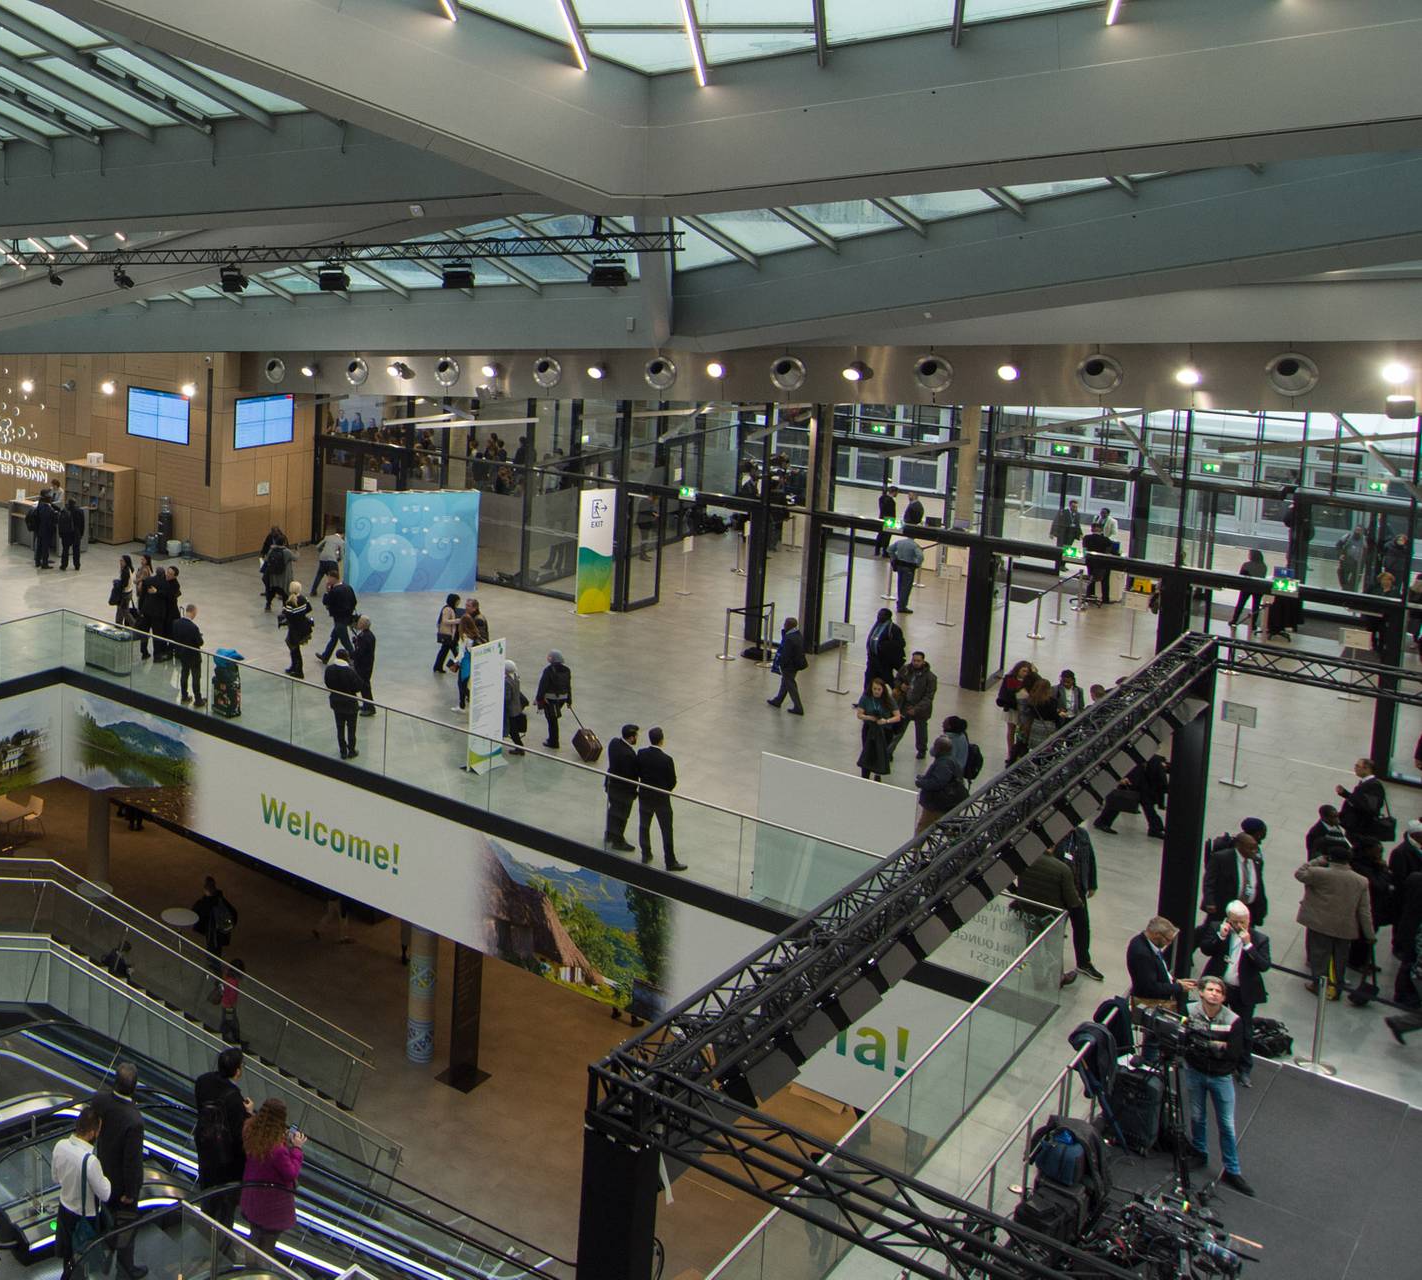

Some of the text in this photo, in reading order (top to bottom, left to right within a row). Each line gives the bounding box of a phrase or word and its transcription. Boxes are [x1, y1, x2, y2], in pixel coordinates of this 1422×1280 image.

[16, 465, 48, 484] BONN
[590, 520, 603, 528] EXIT
[261, 792, 399, 875] Welcome!
